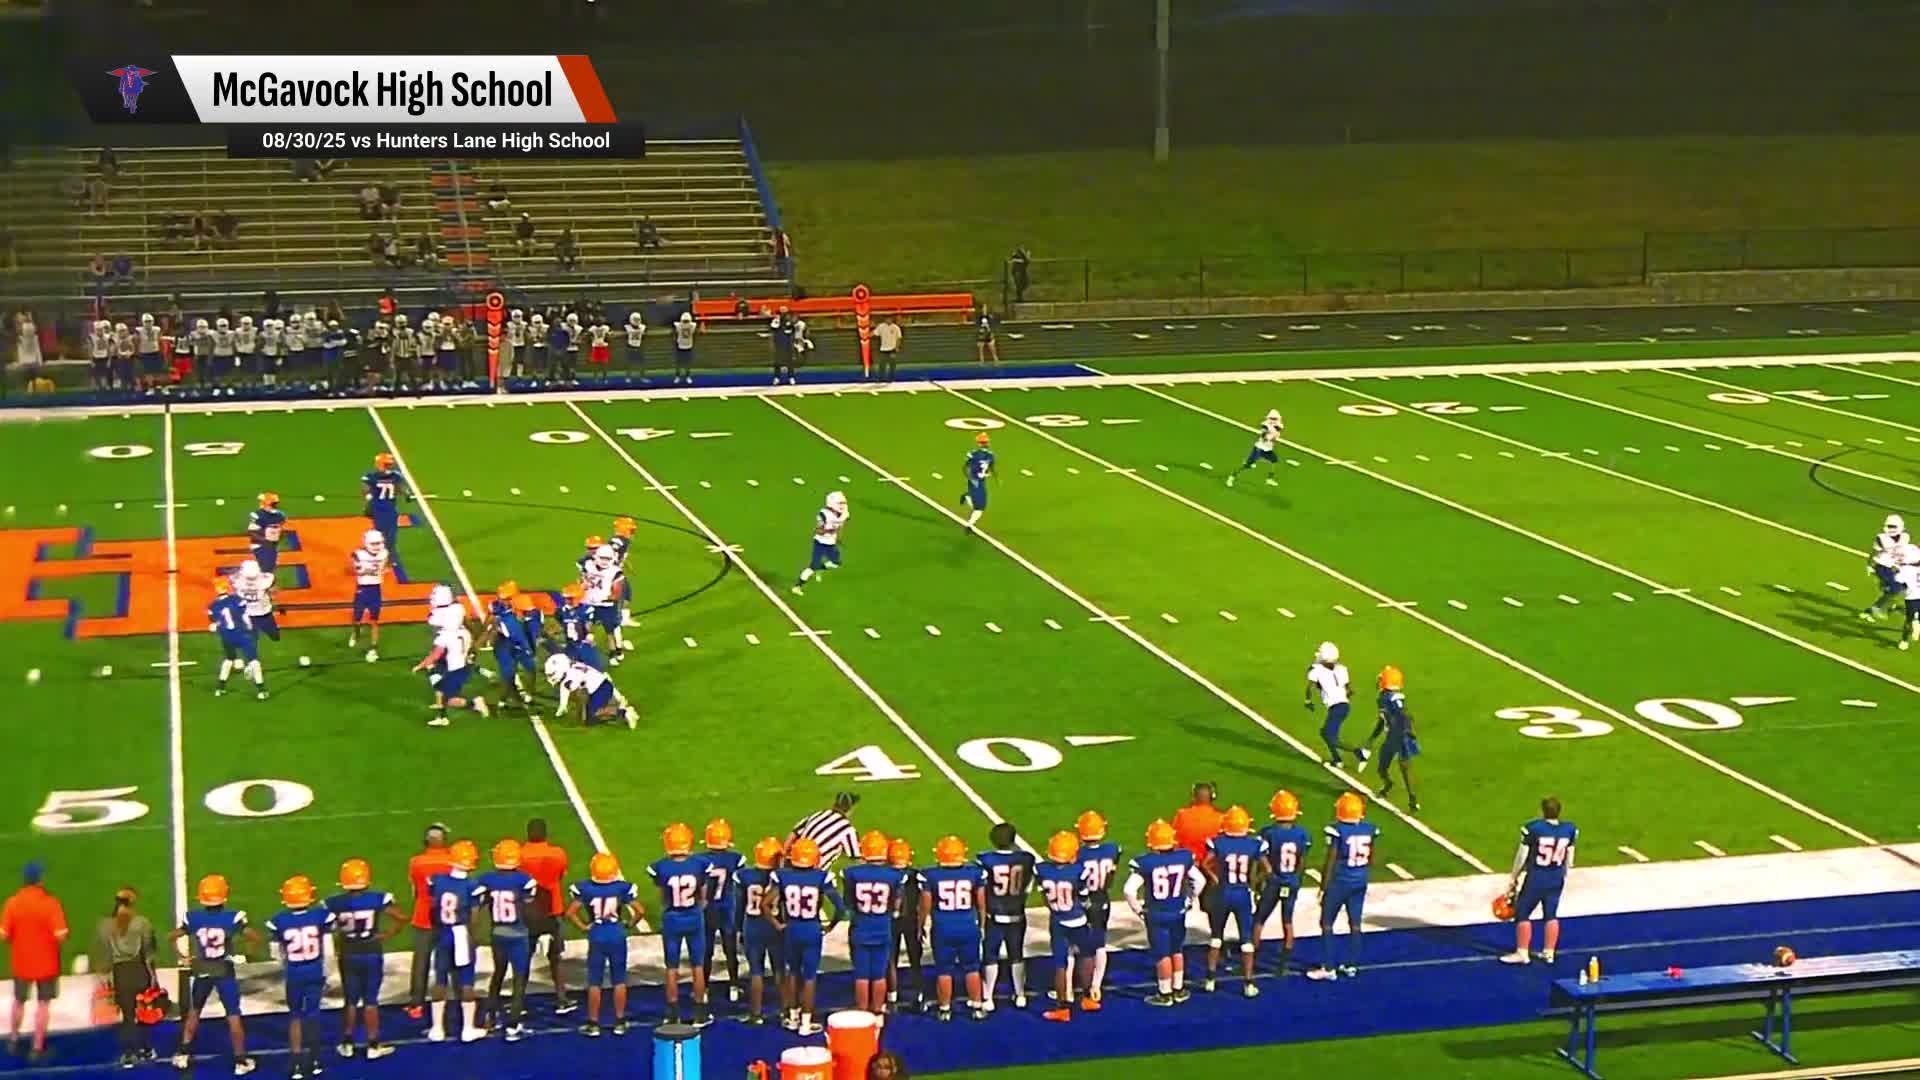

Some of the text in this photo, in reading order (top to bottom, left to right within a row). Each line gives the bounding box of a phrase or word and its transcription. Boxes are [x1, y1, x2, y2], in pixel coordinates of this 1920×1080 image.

[1280, 842, 1297, 873] 6
[1345, 835, 1371, 867] 15
[1536, 837, 1566, 866] 54
[993, 864, 1024, 896] 50
[1151, 864, 1185, 900] 67
[1225, 854, 1249, 884] 11
[490, 890, 516, 923] 16
[667, 874, 697, 908] 12
[785, 884, 819, 919] 83
[856, 882, 890, 914] 53
[938, 880, 973, 911] 56
[440, 892, 458, 924] 8
[284, 926, 320, 961] 26
